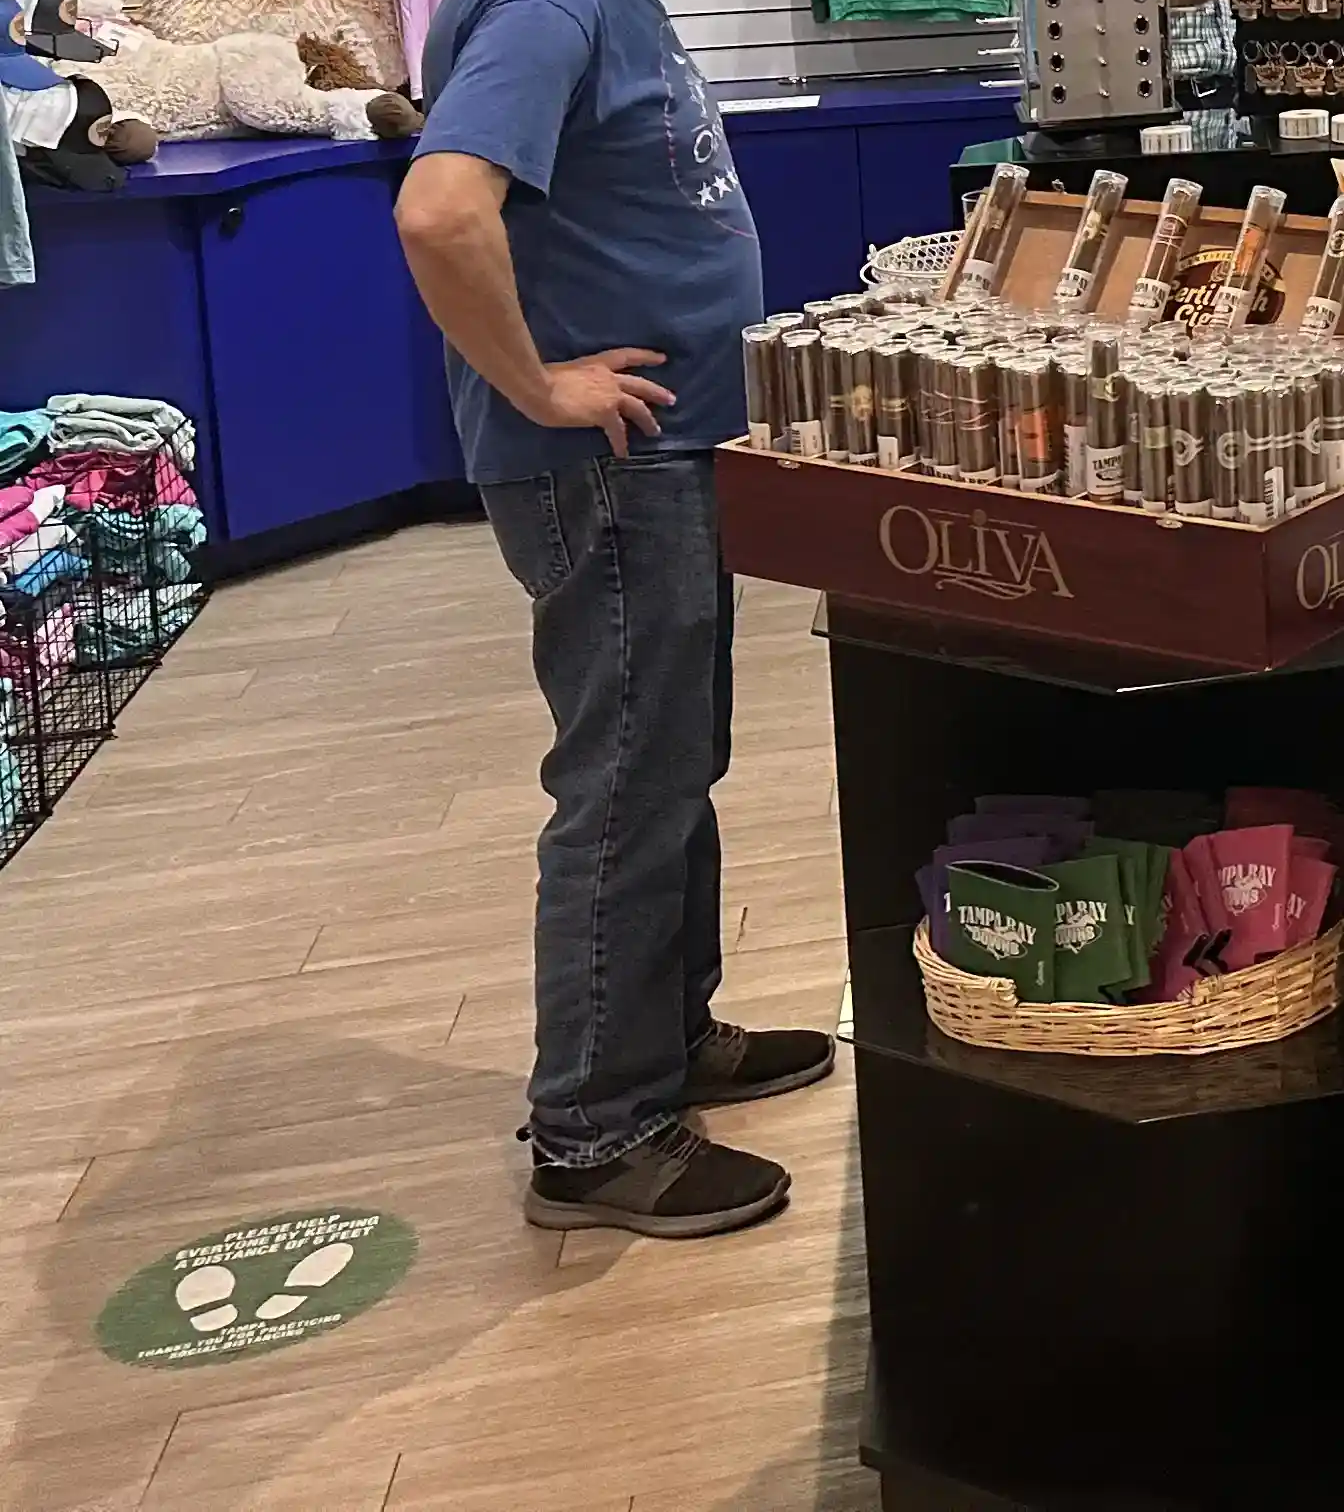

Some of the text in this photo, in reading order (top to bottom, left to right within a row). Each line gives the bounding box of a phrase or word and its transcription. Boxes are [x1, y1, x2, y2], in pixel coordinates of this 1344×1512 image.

[880, 505, 1075, 599] OLIVA
[1249, 863, 1277, 887] BAY
[1076, 900, 1107, 922] BAY
[1287, 892, 1307, 919] AY
[958, 905, 1037, 945] TAMPA BAY
[971, 926, 1020, 956] DOWNS
[175, 1215, 380, 1261] EVERYONE BY KEEPING
[224, 1214, 341, 1242] PLEASE HELP
[173, 1259, 188, 1271] A
[192, 1244, 281, 1266] DISTANCE
[285, 1238, 310, 1250] OF
[328, 1226, 374, 1242] FEET
[168, 1328, 305, 1360] SOCIAL DISTANCING
[198, 1335, 224, 1347] YOU
[235, 1329, 257, 1341] FOR
[259, 1313, 342, 1335] PRACTICING
[220, 1321, 266, 1336] TAMPA
